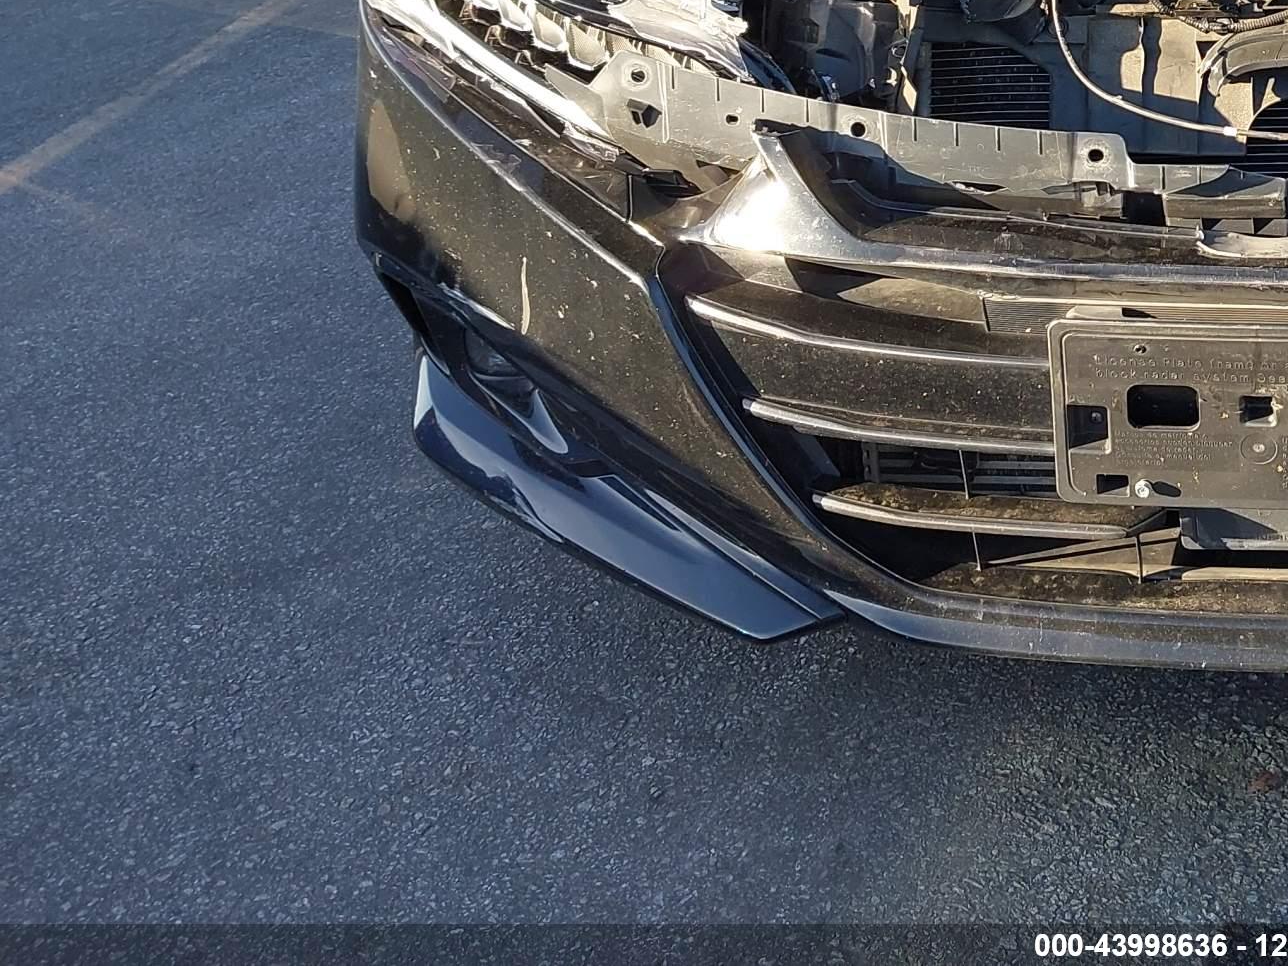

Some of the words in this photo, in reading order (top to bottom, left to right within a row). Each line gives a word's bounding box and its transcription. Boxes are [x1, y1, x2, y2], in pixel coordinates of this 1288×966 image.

[1095, 354, 1156, 367] License
[1163, 357, 1202, 369] Plate
[1209, 357, 1254, 371] frame
[1095, 367, 1137, 379] block
[1143, 368, 1185, 380] radar
[1257, 372, 1286, 384] See
